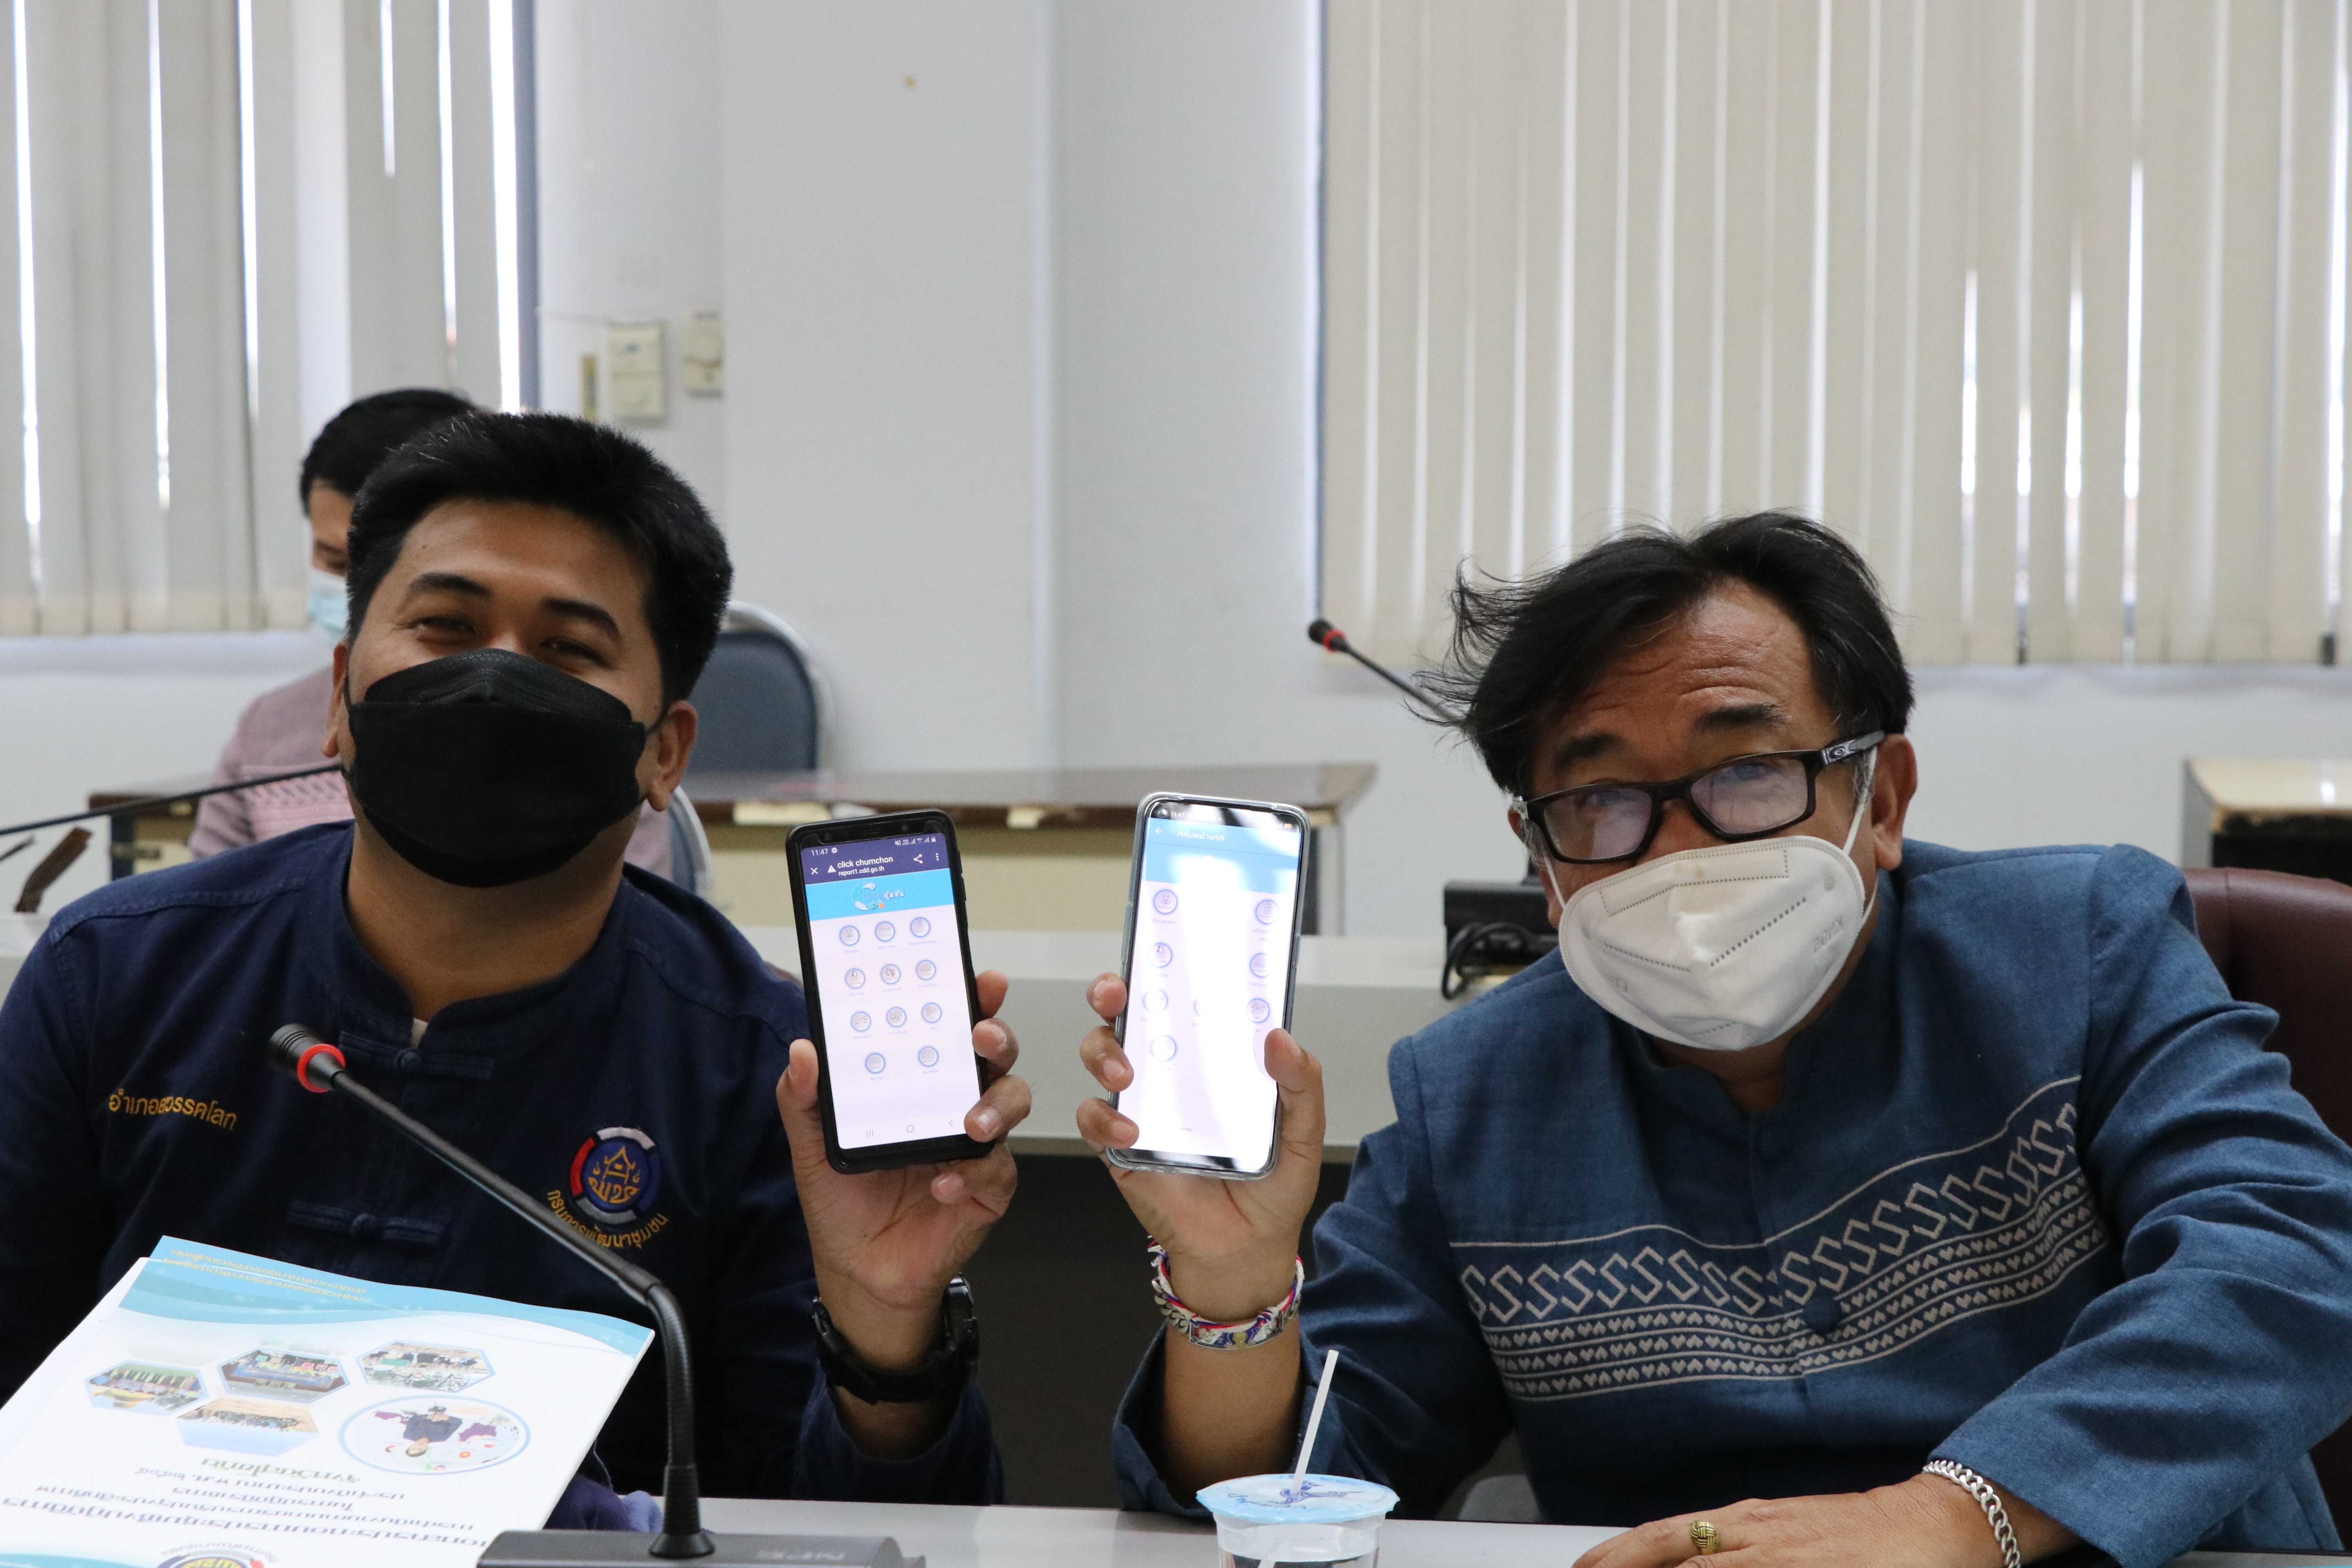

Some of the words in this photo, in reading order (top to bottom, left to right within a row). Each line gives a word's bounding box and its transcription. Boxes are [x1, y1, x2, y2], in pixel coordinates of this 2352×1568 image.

[1177, 830, 1225, 842] กลับหน้าแรก
[837, 860, 854, 868] click
[855, 857, 893, 866] chumchon
[838, 866, 885, 877] report1.cdd.go.th
[109, 1088, 237, 1131] อำเภอสวรรคโลก
